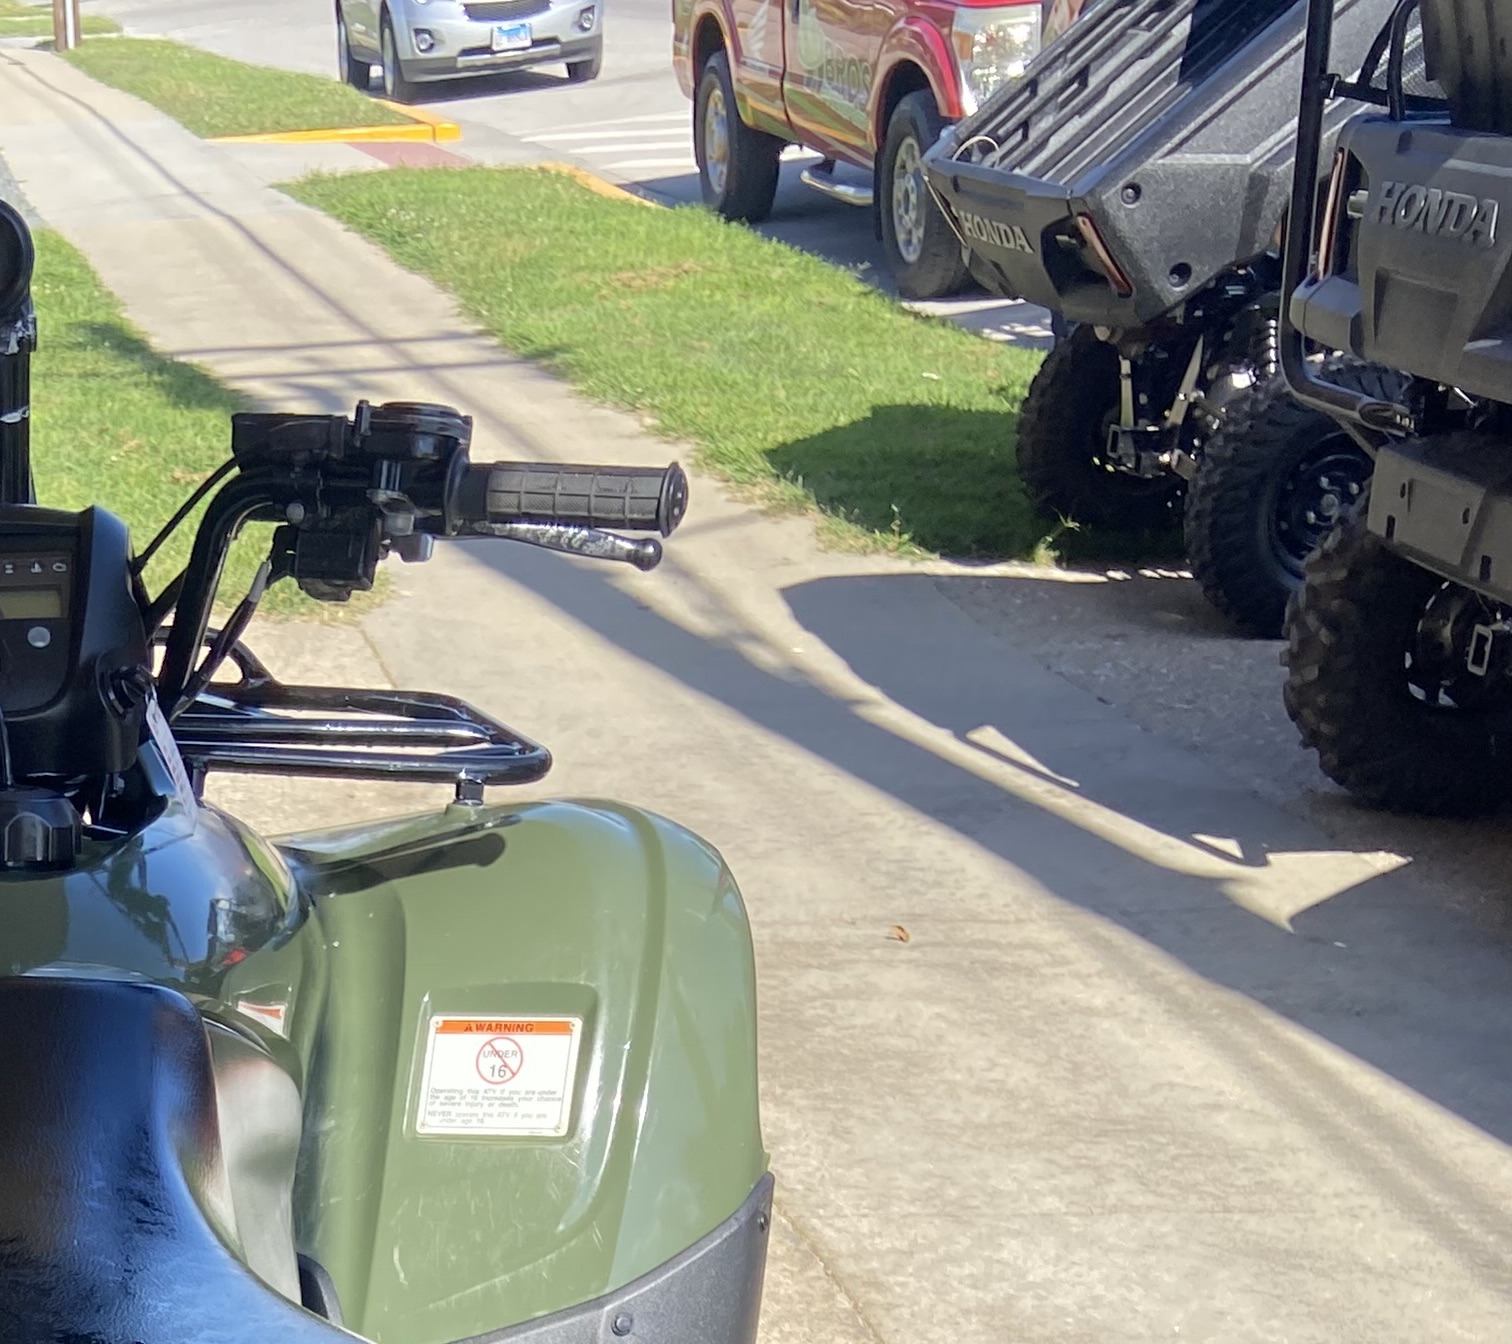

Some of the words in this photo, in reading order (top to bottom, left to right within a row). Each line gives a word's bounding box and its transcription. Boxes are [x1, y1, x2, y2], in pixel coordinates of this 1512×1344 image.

[1371, 181, 1502, 247] HONDA
[958, 210, 1034, 254] HONDA
[476, 1024, 534, 1032] WARNING
[482, 1050, 518, 1058] UNDER
[489, 1065, 506, 1078] 16
